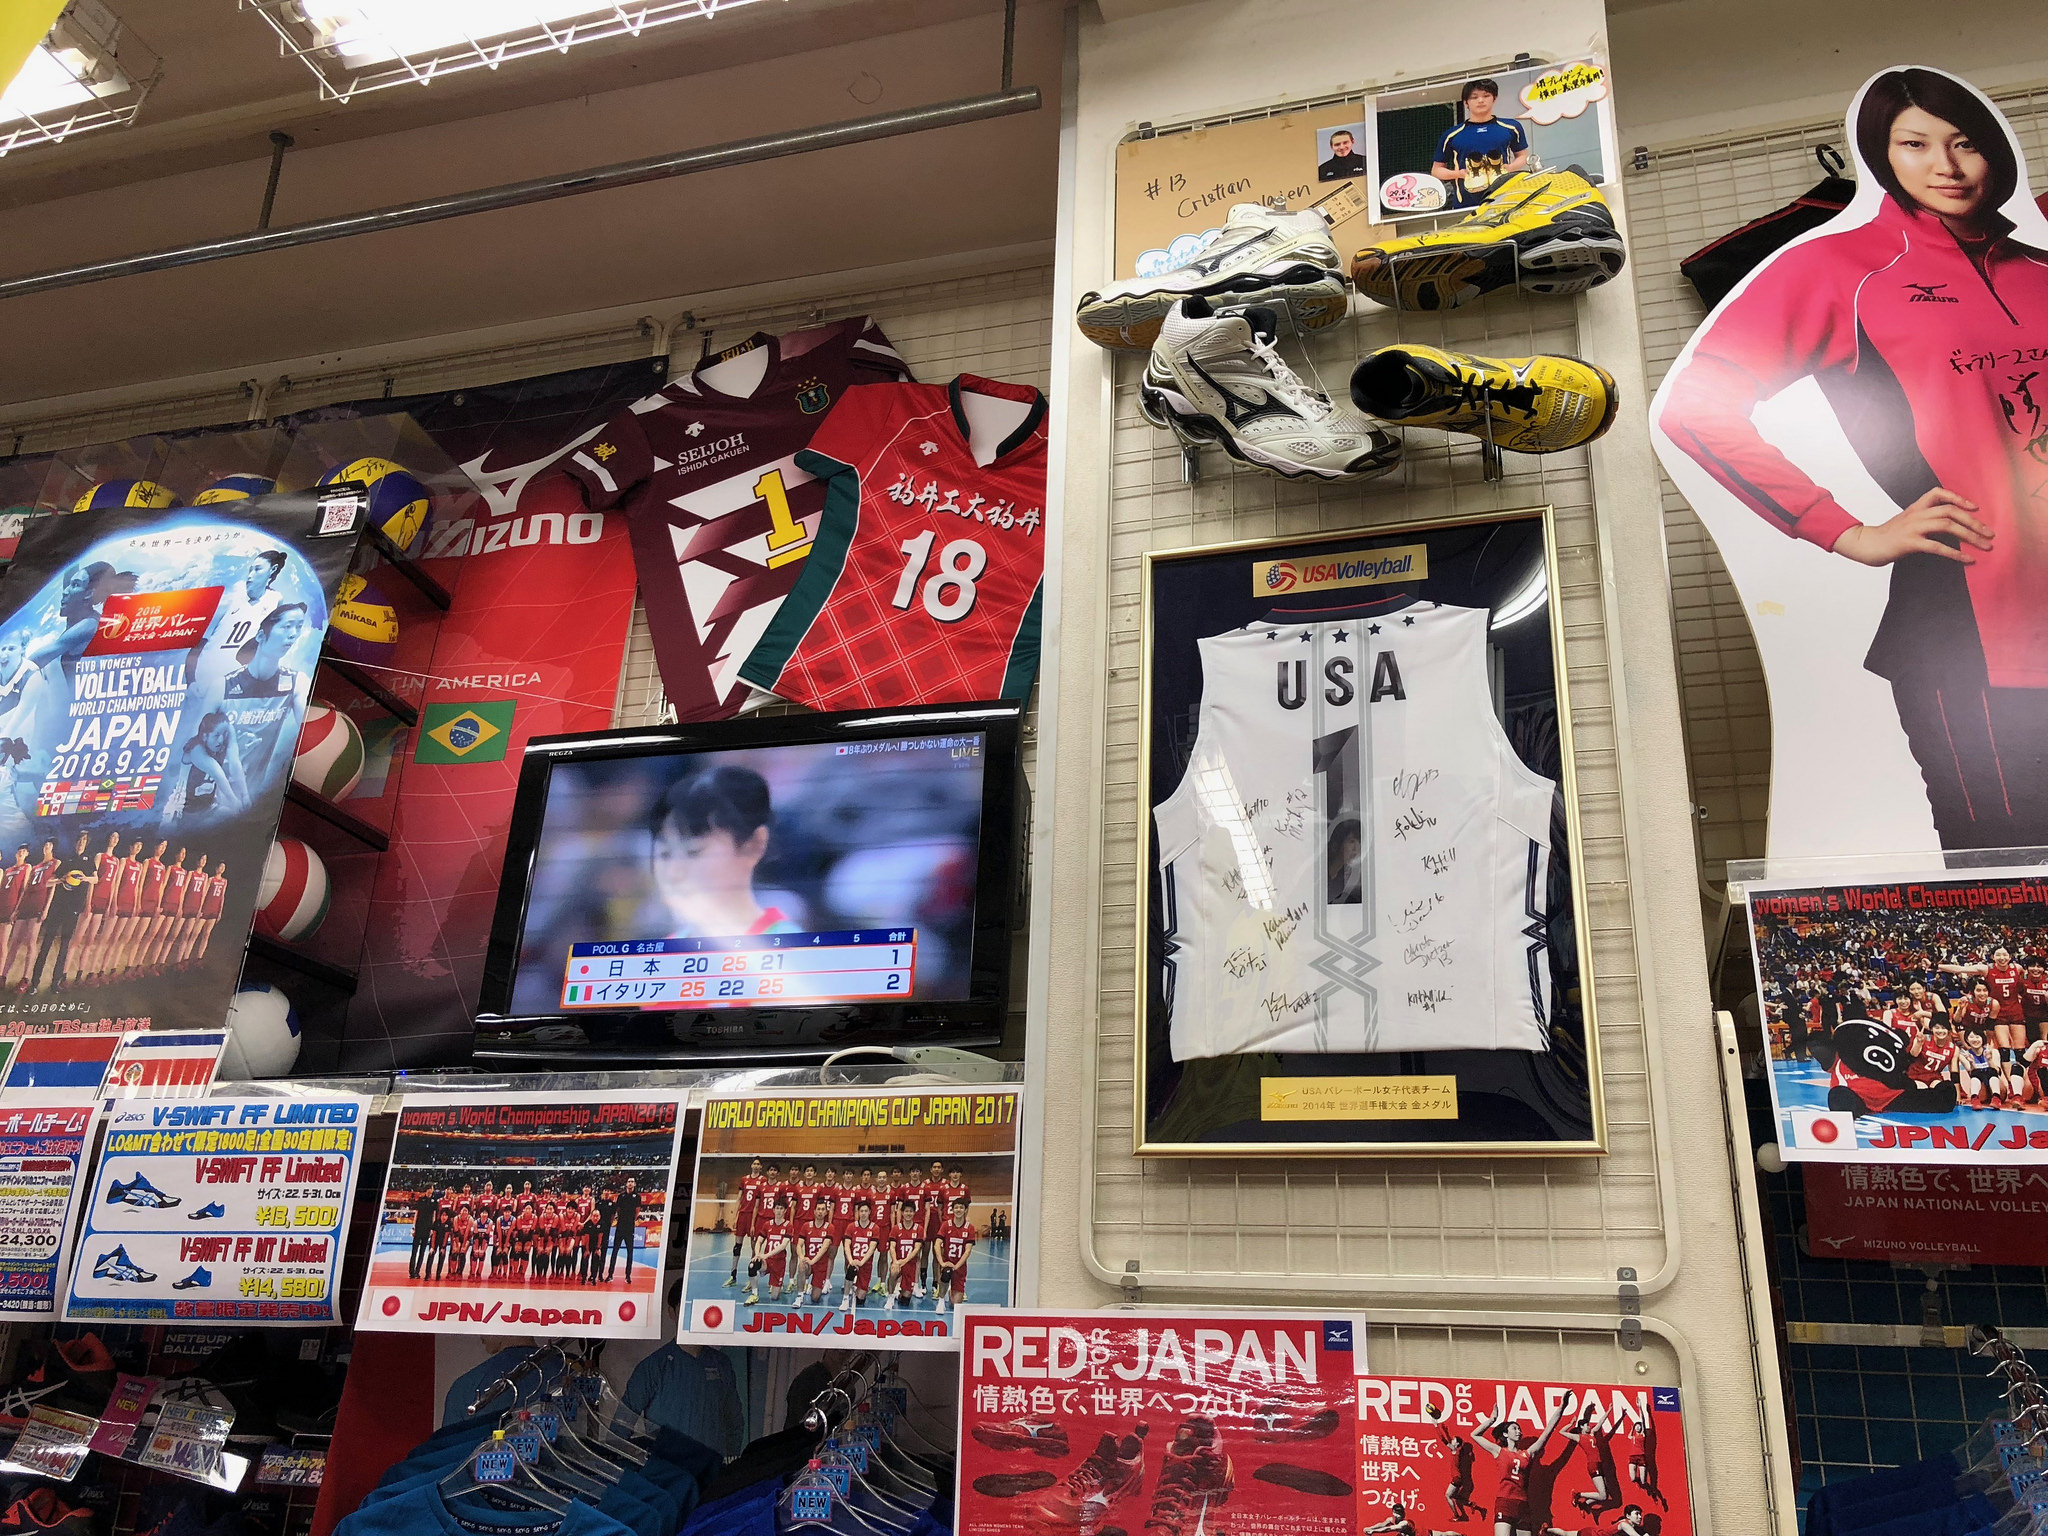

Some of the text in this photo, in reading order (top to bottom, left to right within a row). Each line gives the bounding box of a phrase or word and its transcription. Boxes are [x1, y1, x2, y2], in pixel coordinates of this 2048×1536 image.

[677, 444, 750, 476] ISHIDA GAKUEN
[678, 433, 745, 466] SEIJOH
[753, 468, 807, 552] 1
[892, 529, 988, 622] 18
[130, 612, 207, 633] 世界バレー
[136, 605, 162, 617] 2018
[226, 620, 252, 646] 10
[75, 655, 142, 674] FIVB WOMEN'S
[74, 664, 188, 701] VOLLEYBALL
[435, 672, 542, 691] AMERICA
[1277, 650, 1406, 710] USA
[69, 693, 186, 718] WORLD CHAMPIONSHIP
[56, 711, 183, 753] JAPAN
[50, 747, 170, 780] 2018.9.29
[951, 747, 980, 758] LIVE
[1843, 887, 1901, 911] World
[592, 943, 619, 955] POOL
[622, 943, 630, 953] G
[636, 942, 665, 954] 名古屋
[813, 935, 820, 945] 4
[853, 933, 860, 943] 5
[888, 931, 907, 942] 合計
[683, 957, 708, 974] 20
[721, 955, 748, 972] 25
[761, 953, 784, 970] 21
[891, 949, 898, 965] 1
[597, 974, 900, 1001] イタリア 25 22 25 2
[706, 1025, 744, 1035] TOSHIBA
[1924, 1059, 1941, 1071] 21
[1302, 1085, 1450, 1095] USA バレーボール女子代表チーム
[152, 1105, 235, 1126] V-SWIFT
[239, 1104, 269, 1125] FF
[274, 1103, 360, 1124] LIMITED
[460, 1107, 496, 1126] World
[499, 1105, 590, 1127] Championship
[593, 1104, 675, 1124] JAPAN2018
[707, 1096, 1014, 1128] WORLD GRAND CHAMPIONS CUP JAPAN 2017
[1302, 1101, 1335, 1110] 2014年
[1412, 1101, 1451, 1110] 金メダル
[195, 1156, 344, 1184] V-SWIFT FF Limited
[1844, 1196, 1899, 1208] JAPAN
[1904, 1198, 1986, 1211] NATIONAL
[179, 1237, 329, 1263] V-SWIFT FF MT Limited
[853, 1243, 869, 1256] 22
[949, 1245, 963, 1258] 21
[1863, 1239, 1981, 1253] MIZUNO VOLLEYBALL
[417, 1301, 603, 1326] JPN/Japan
[742, 1311, 948, 1338] JPN/Japan
[972, 1325, 1088, 1379] RED
[1114, 1328, 1318, 1384] JAPAN
[1357, 1378, 1652, 1434] RED FOR JAPAN
[1360, 1434, 1443, 1459] 情熱色で、
[481, 1459, 508, 1470] NEW
[1361, 1460, 1421, 1482] 世界へ
[798, 1497, 827, 1508] NEW
